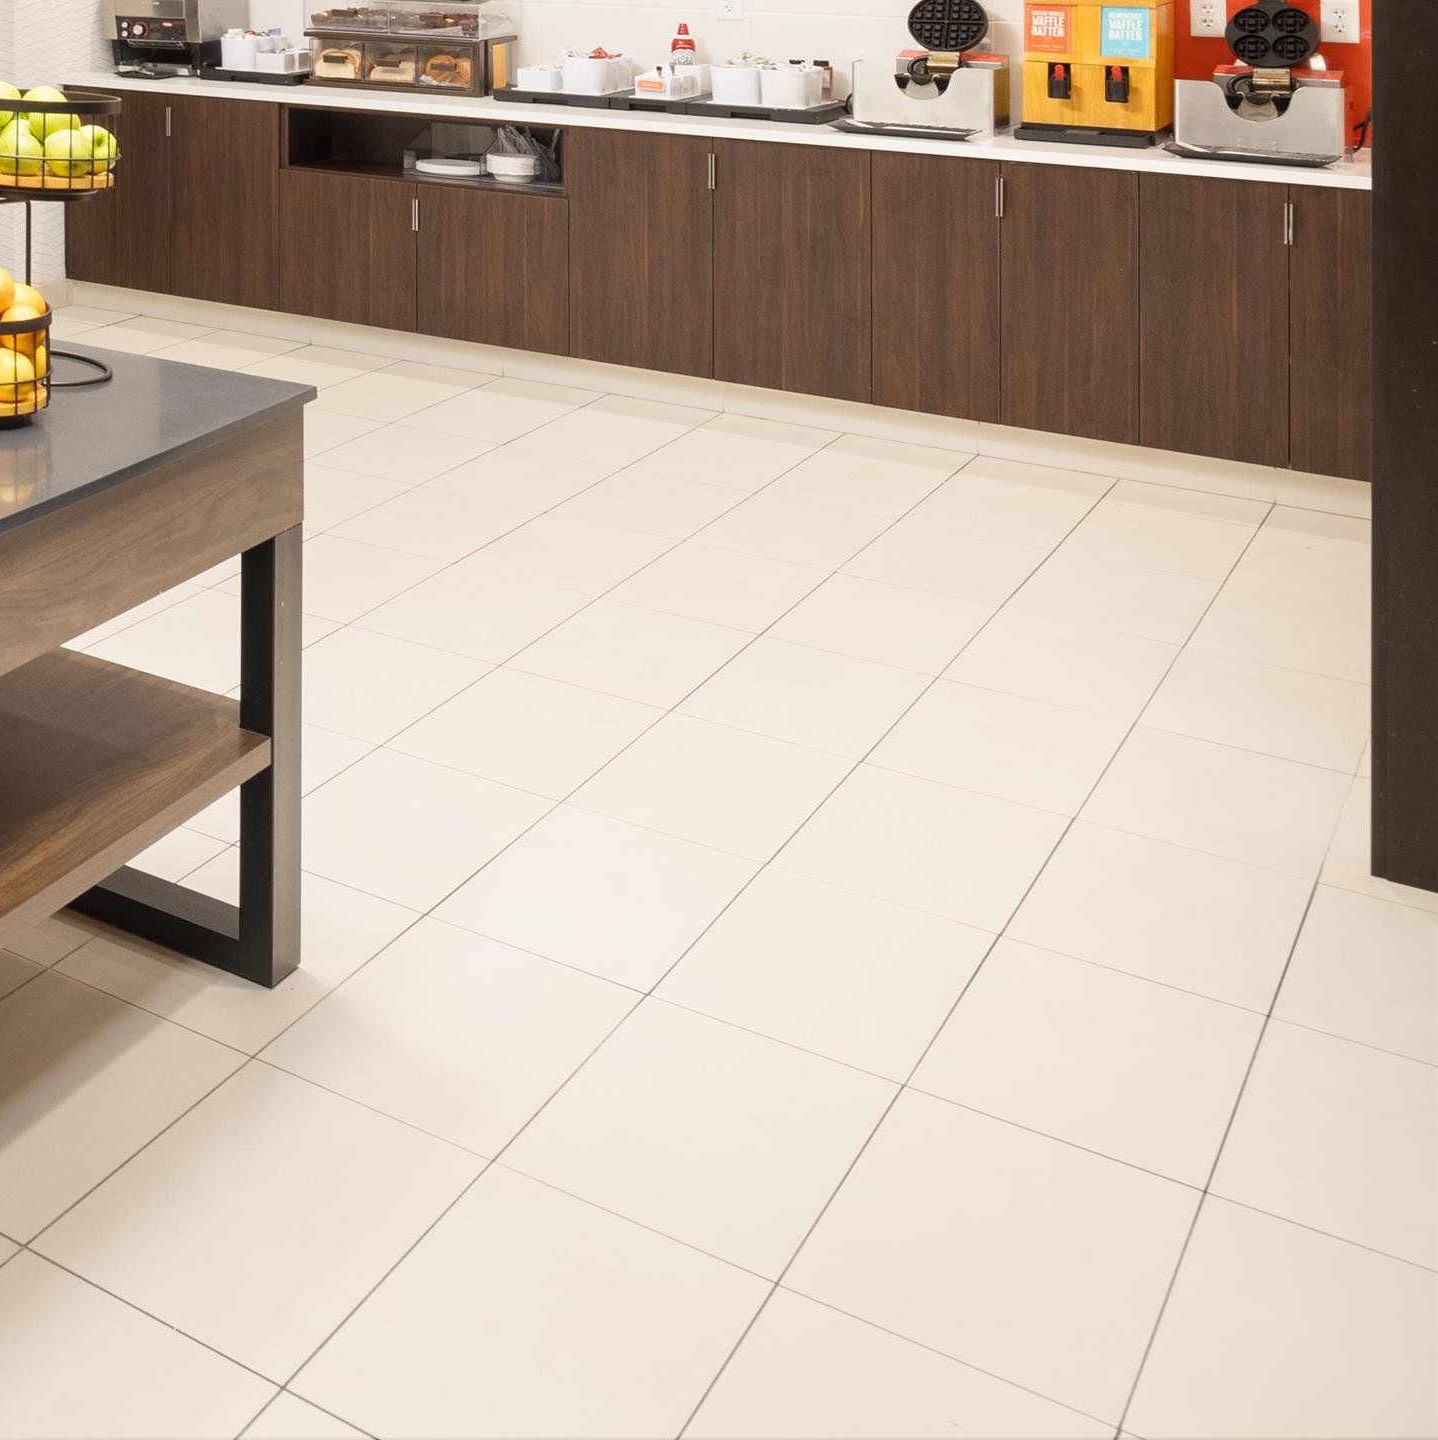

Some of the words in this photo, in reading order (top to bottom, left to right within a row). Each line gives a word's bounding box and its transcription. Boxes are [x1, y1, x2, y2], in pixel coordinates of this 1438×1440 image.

[1031, 15, 1065, 27] WAFFLE
[1108, 19, 1143, 30] WAFFLE
[1031, 26, 1064, 37] BATTER
[1108, 29, 1143, 41] BATTER
